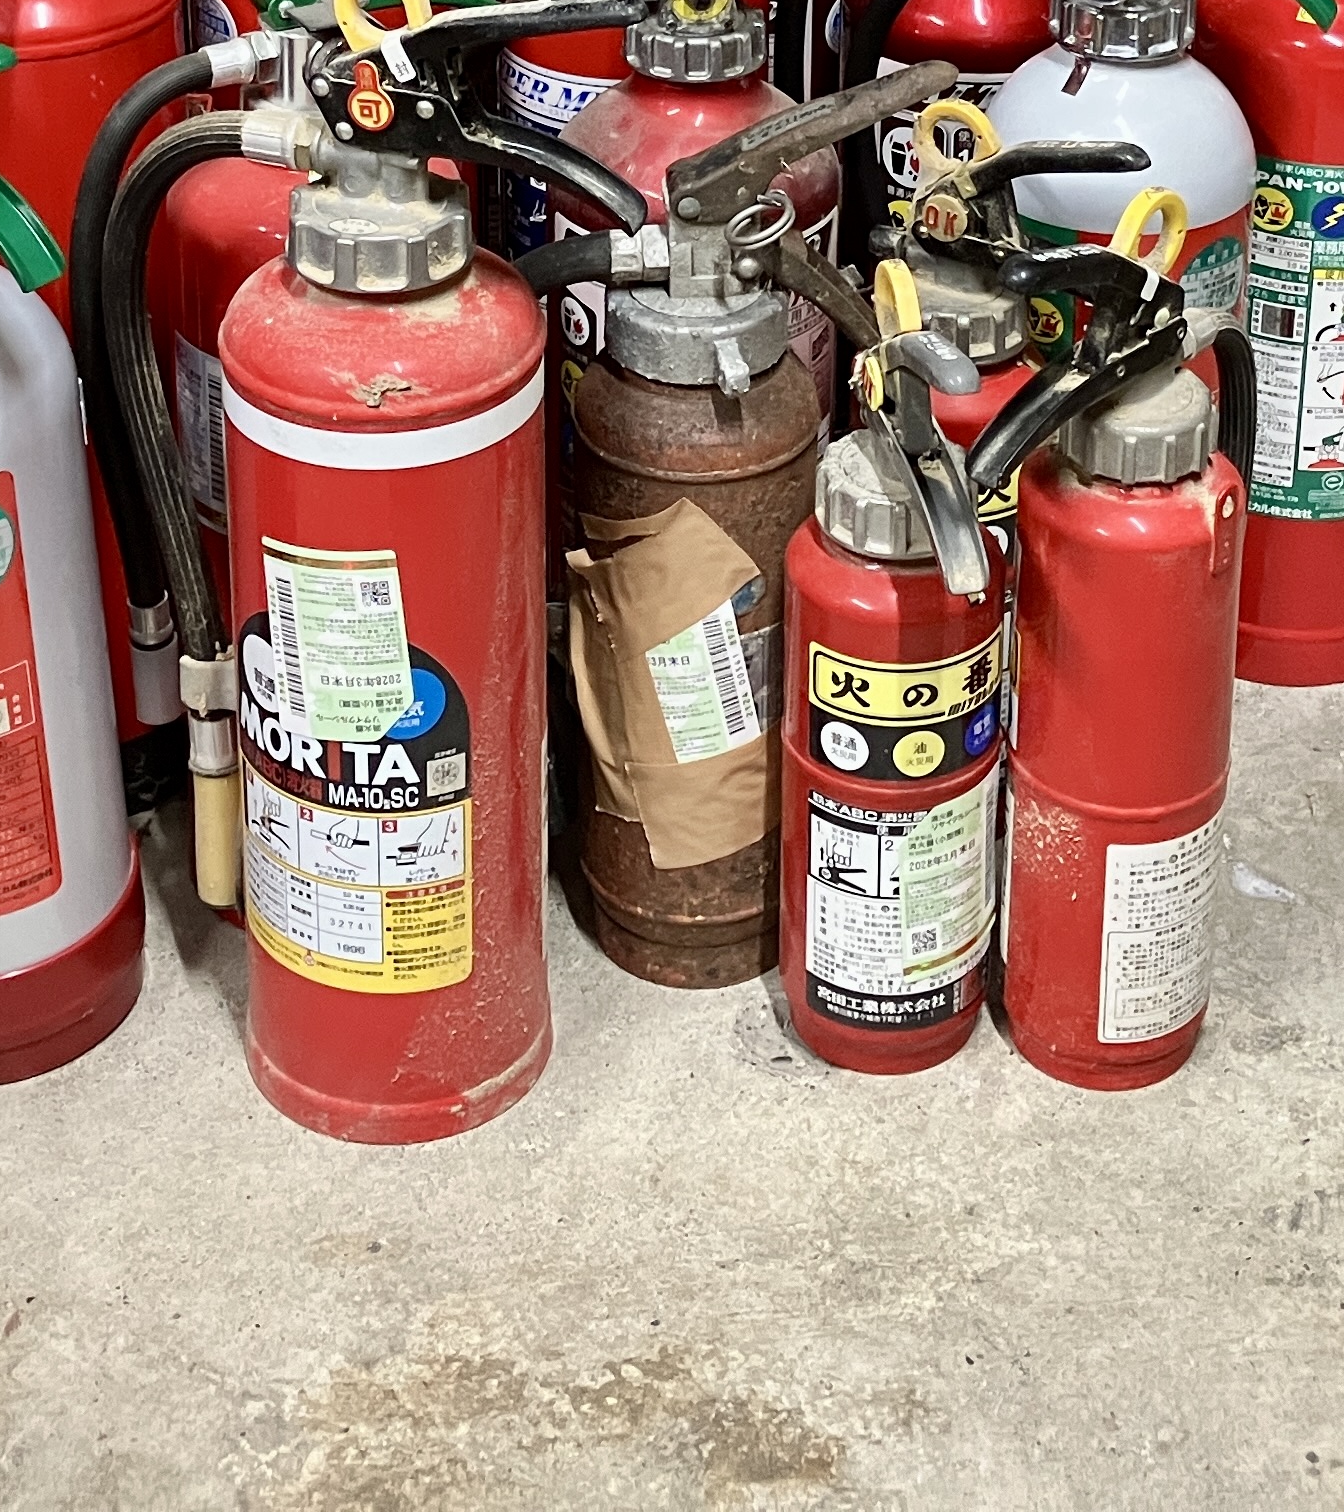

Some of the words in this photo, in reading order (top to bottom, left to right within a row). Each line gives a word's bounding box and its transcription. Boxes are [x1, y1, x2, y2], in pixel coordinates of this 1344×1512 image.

[356, 98, 381, 125] 可
[925, 204, 958, 237] OK
[647, 654, 692, 669] 3月末日
[319, 672, 402, 688] 2028年3月末日
[830, 650, 994, 708] 火の番
[239, 690, 421, 787] MORITA
[829, 731, 858, 753] 普通
[913, 741, 928, 756] 油
[884, 839, 894, 852] 2
[908, 838, 977, 872] 2028年3月末日
[816, 983, 947, 1016] 宮田工業株式会社
